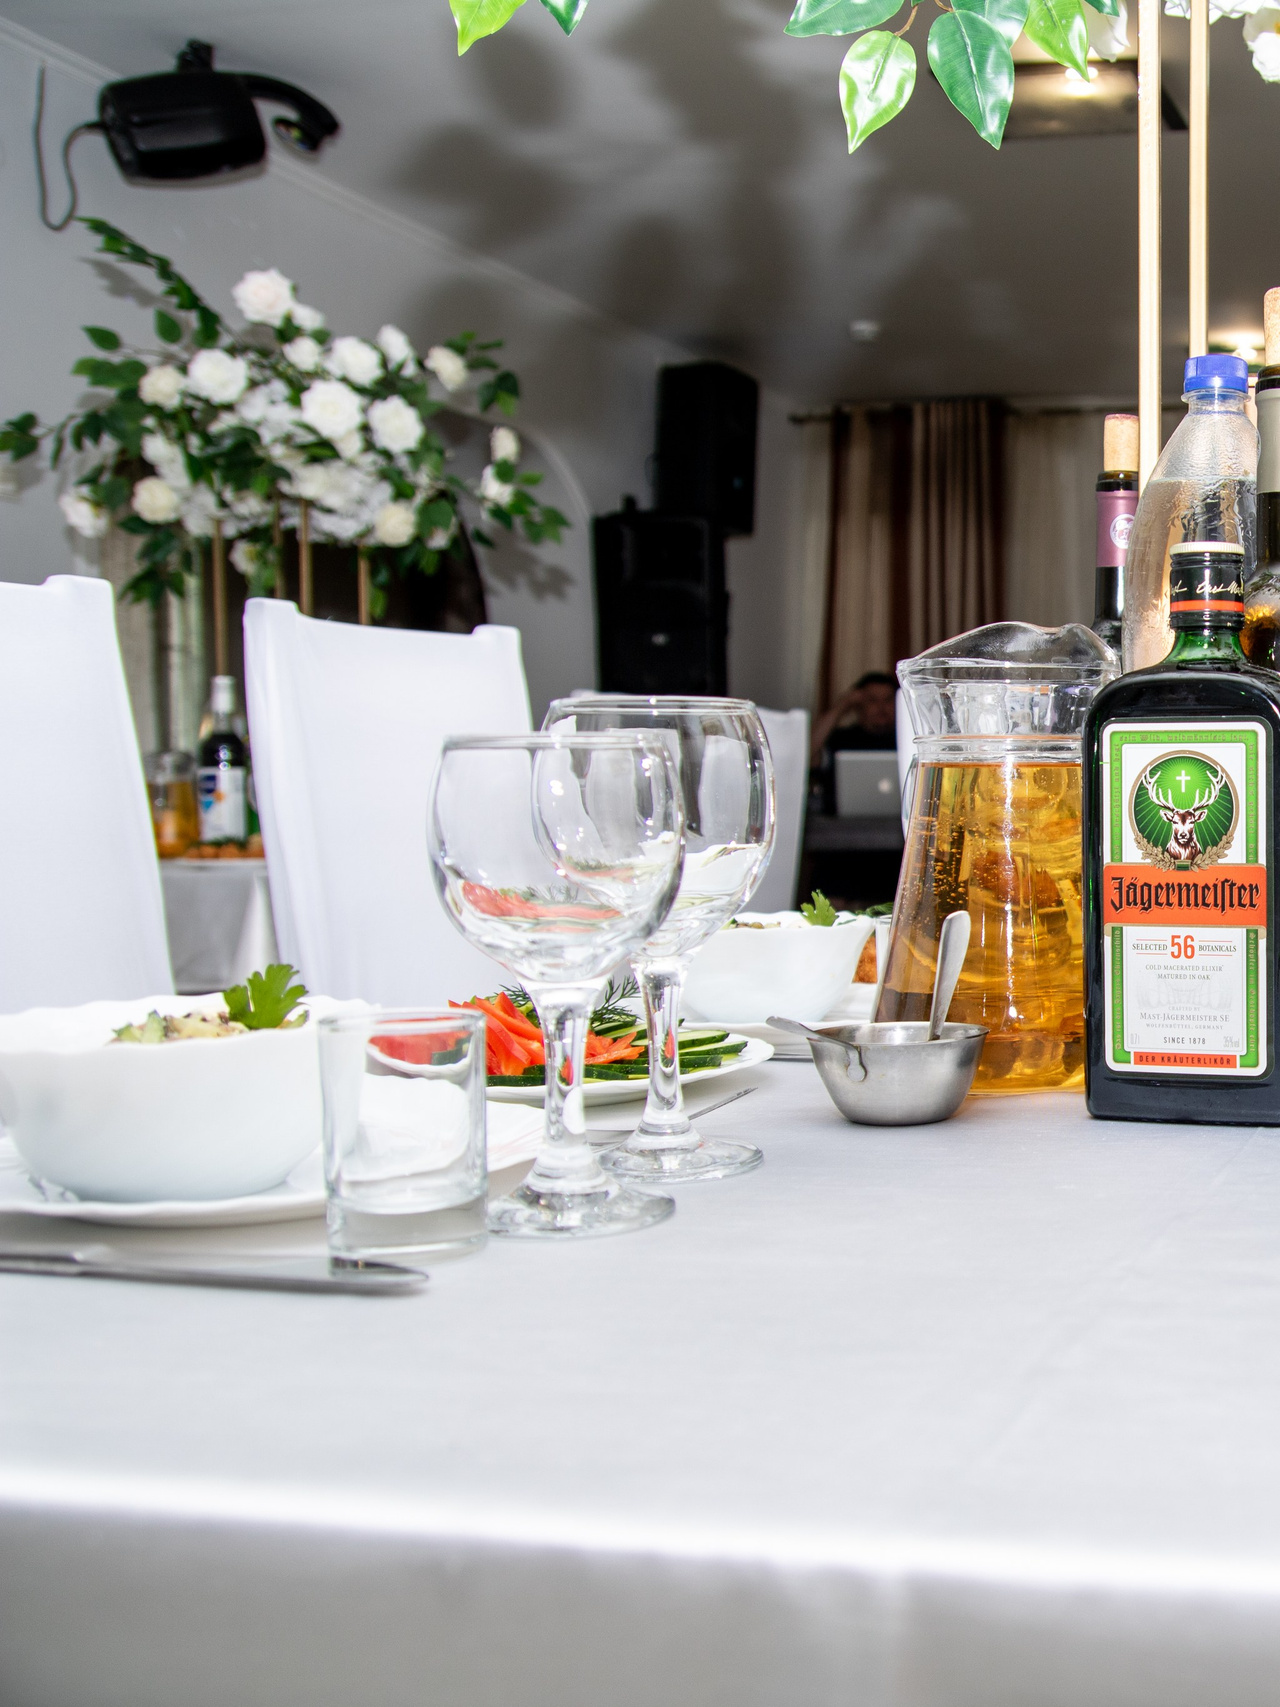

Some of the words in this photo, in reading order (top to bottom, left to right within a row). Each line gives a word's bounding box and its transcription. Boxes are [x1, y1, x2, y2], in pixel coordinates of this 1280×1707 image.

[1132, 943, 1168, 951] SELECTED
[1170, 934, 1196, 960] 56
[1198, 944, 1237, 953] BOTANICALS
[1219, 1014, 1230, 1022] SE
[1163, 1036, 1186, 1045] SINCE
[1188, 1037, 1206, 1045] 1878
[1139, 1055, 1156, 1063] DER
[1161, 1055, 1231, 1065] KRÄUTERLIKÖR
